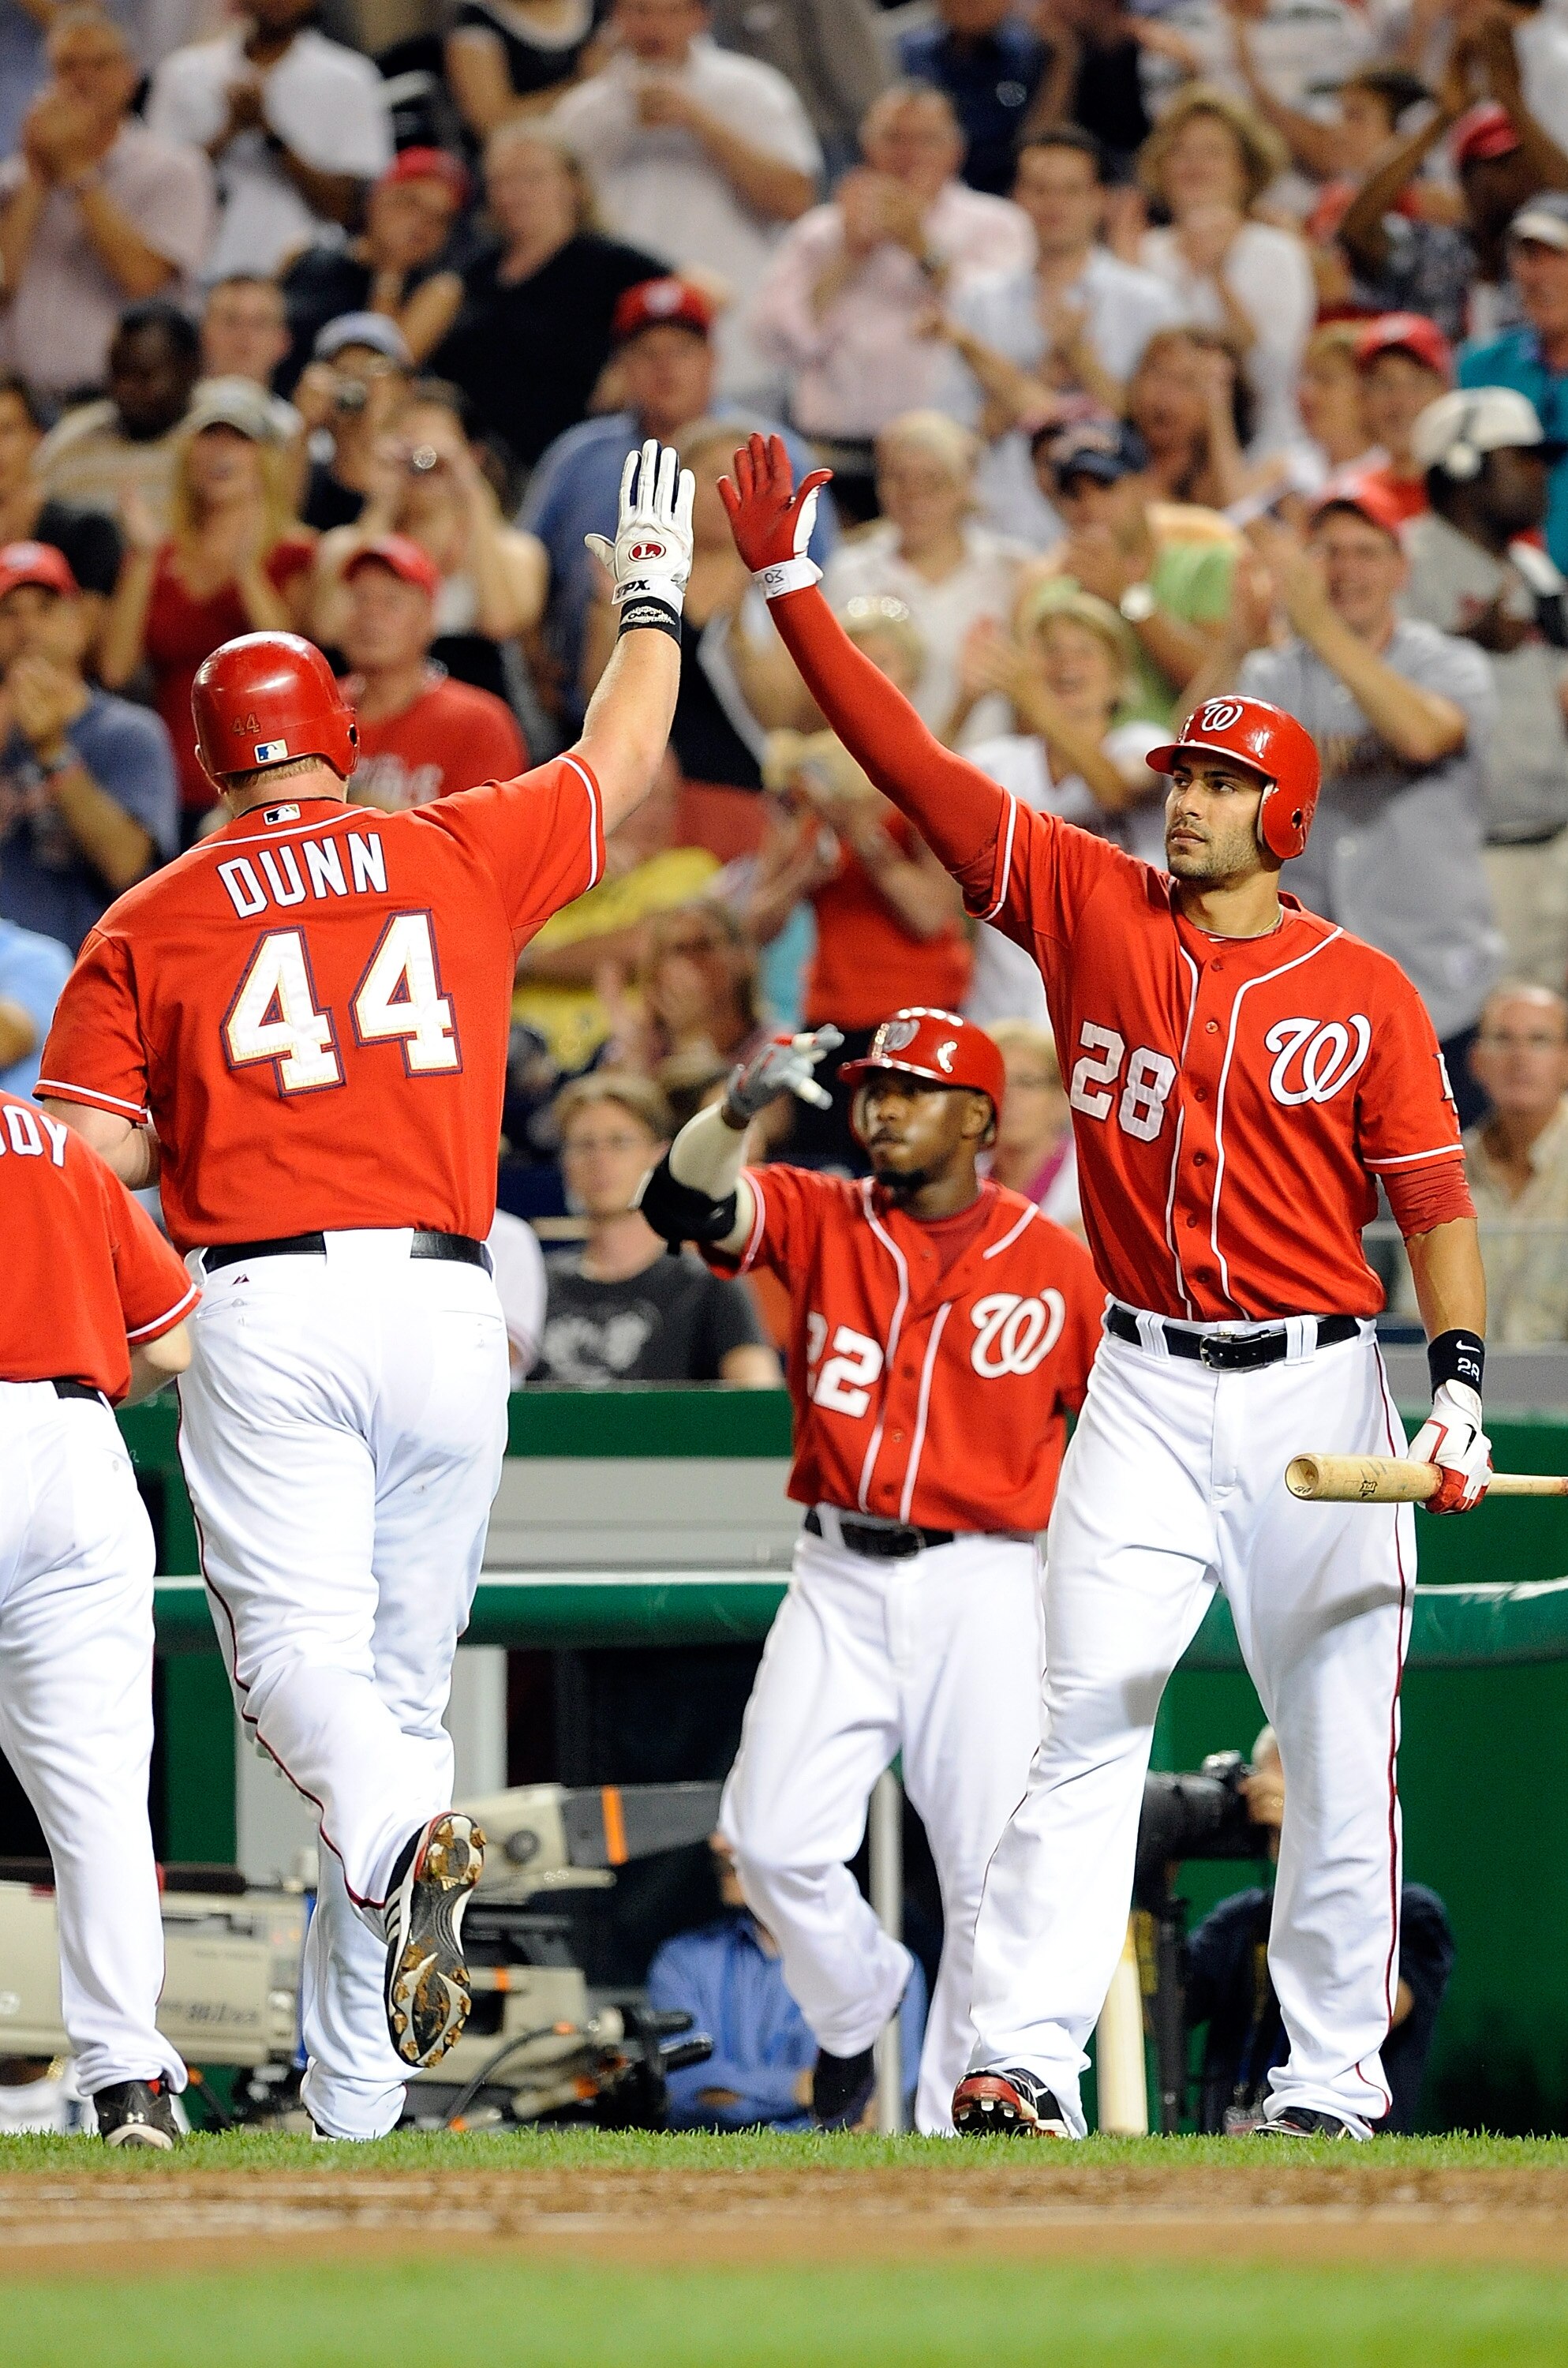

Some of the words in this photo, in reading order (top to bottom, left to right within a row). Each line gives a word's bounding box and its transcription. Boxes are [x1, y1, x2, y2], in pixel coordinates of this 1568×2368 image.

[231, 712, 261, 736] 44
[1201, 703, 1244, 733] W
[216, 832, 388, 920] DUNN
[220, 907, 464, 1098] 44
[1069, 1020, 1178, 1143] 28
[1265, 1014, 1372, 1106] W
[0, 1103, 69, 1168] OY
[970, 1287, 1066, 1379] W
